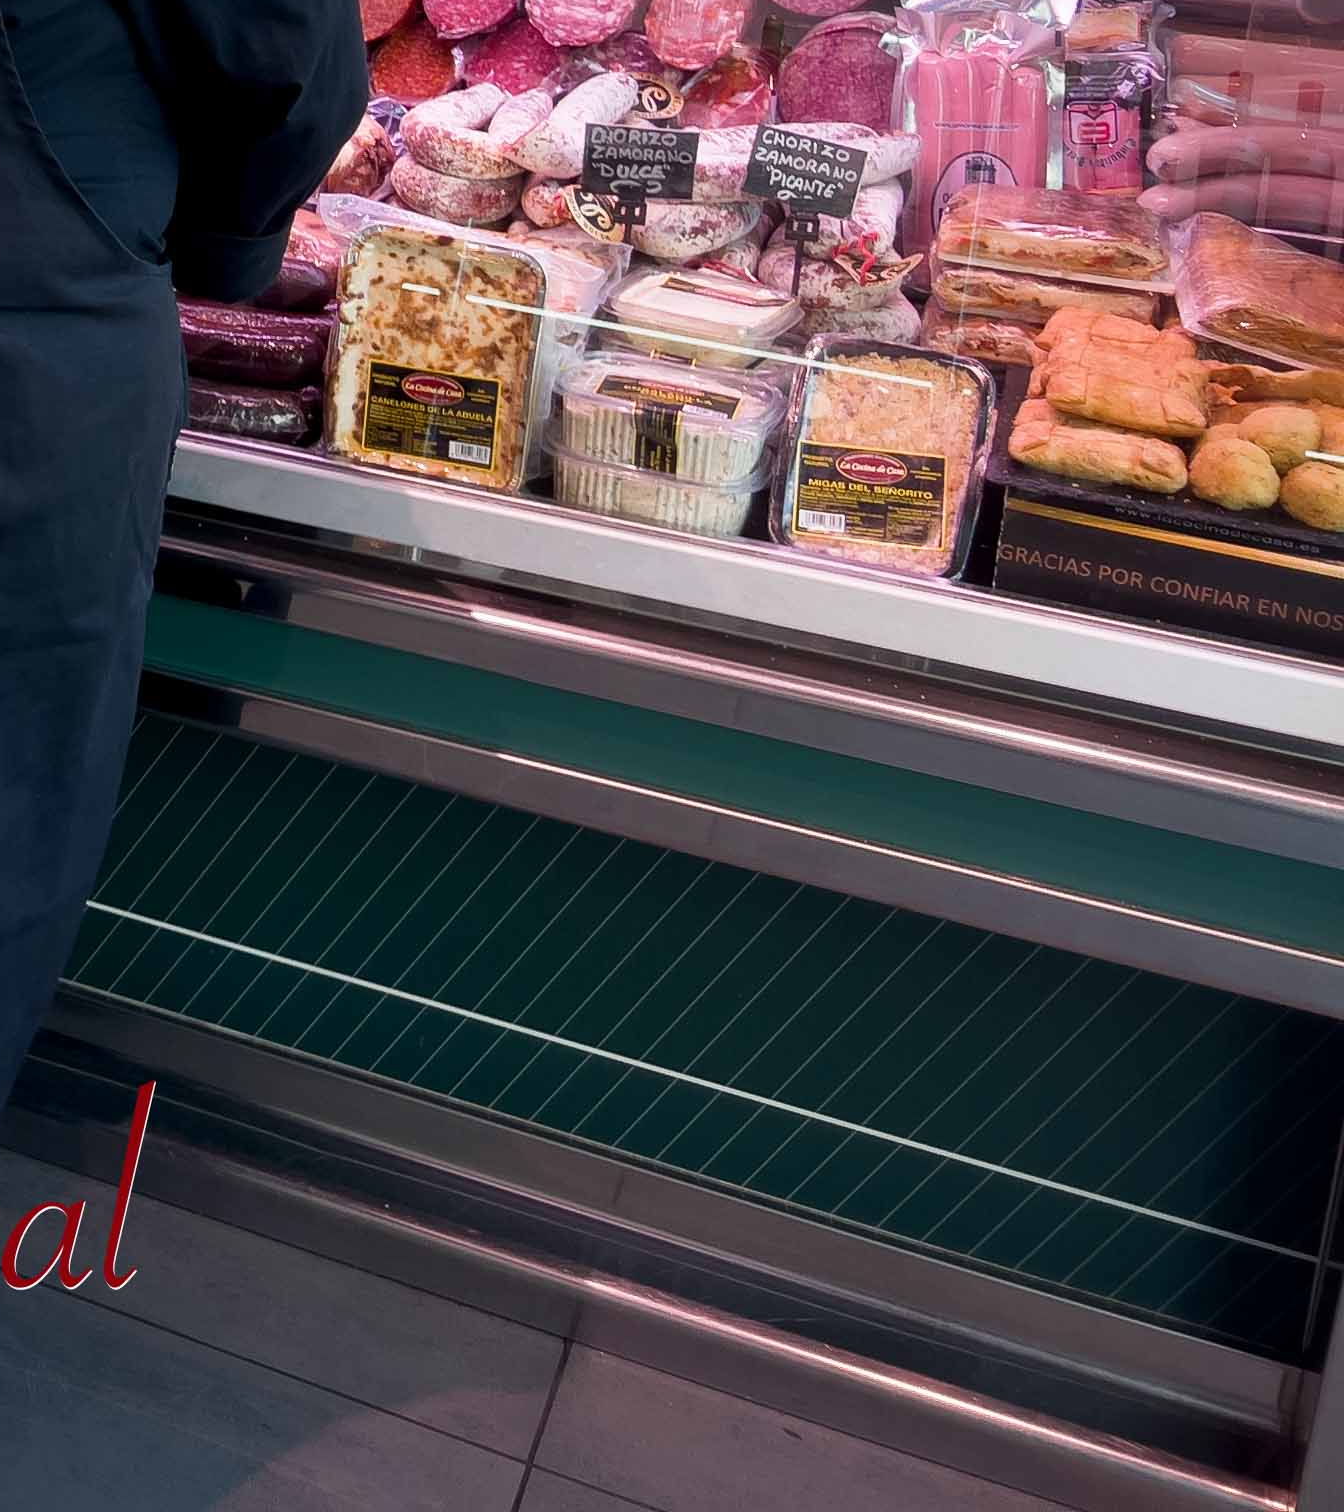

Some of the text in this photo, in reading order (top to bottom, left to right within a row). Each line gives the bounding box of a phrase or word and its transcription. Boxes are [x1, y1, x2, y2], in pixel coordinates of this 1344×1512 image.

[591, 126, 678, 147] CHORIZO
[762, 129, 851, 163] CHORIZO
[591, 145, 694, 165] ZAMORANO
[754, 145, 858, 184] ZAMORANO
[371, 395, 426, 413] CANELONES
[442, 407, 454, 418] LA
[808, 478, 847, 492] MIGAS
[848, 482, 872, 494] DEL
[1113, 504, 1321, 555] www.lacocinadecasa.es
[997, 543, 1092, 578] GRACIAS
[1097, 565, 1144, 590] POR
[1149, 576, 1250, 612] CONFIAR
[1256, 599, 1289, 619] EN
